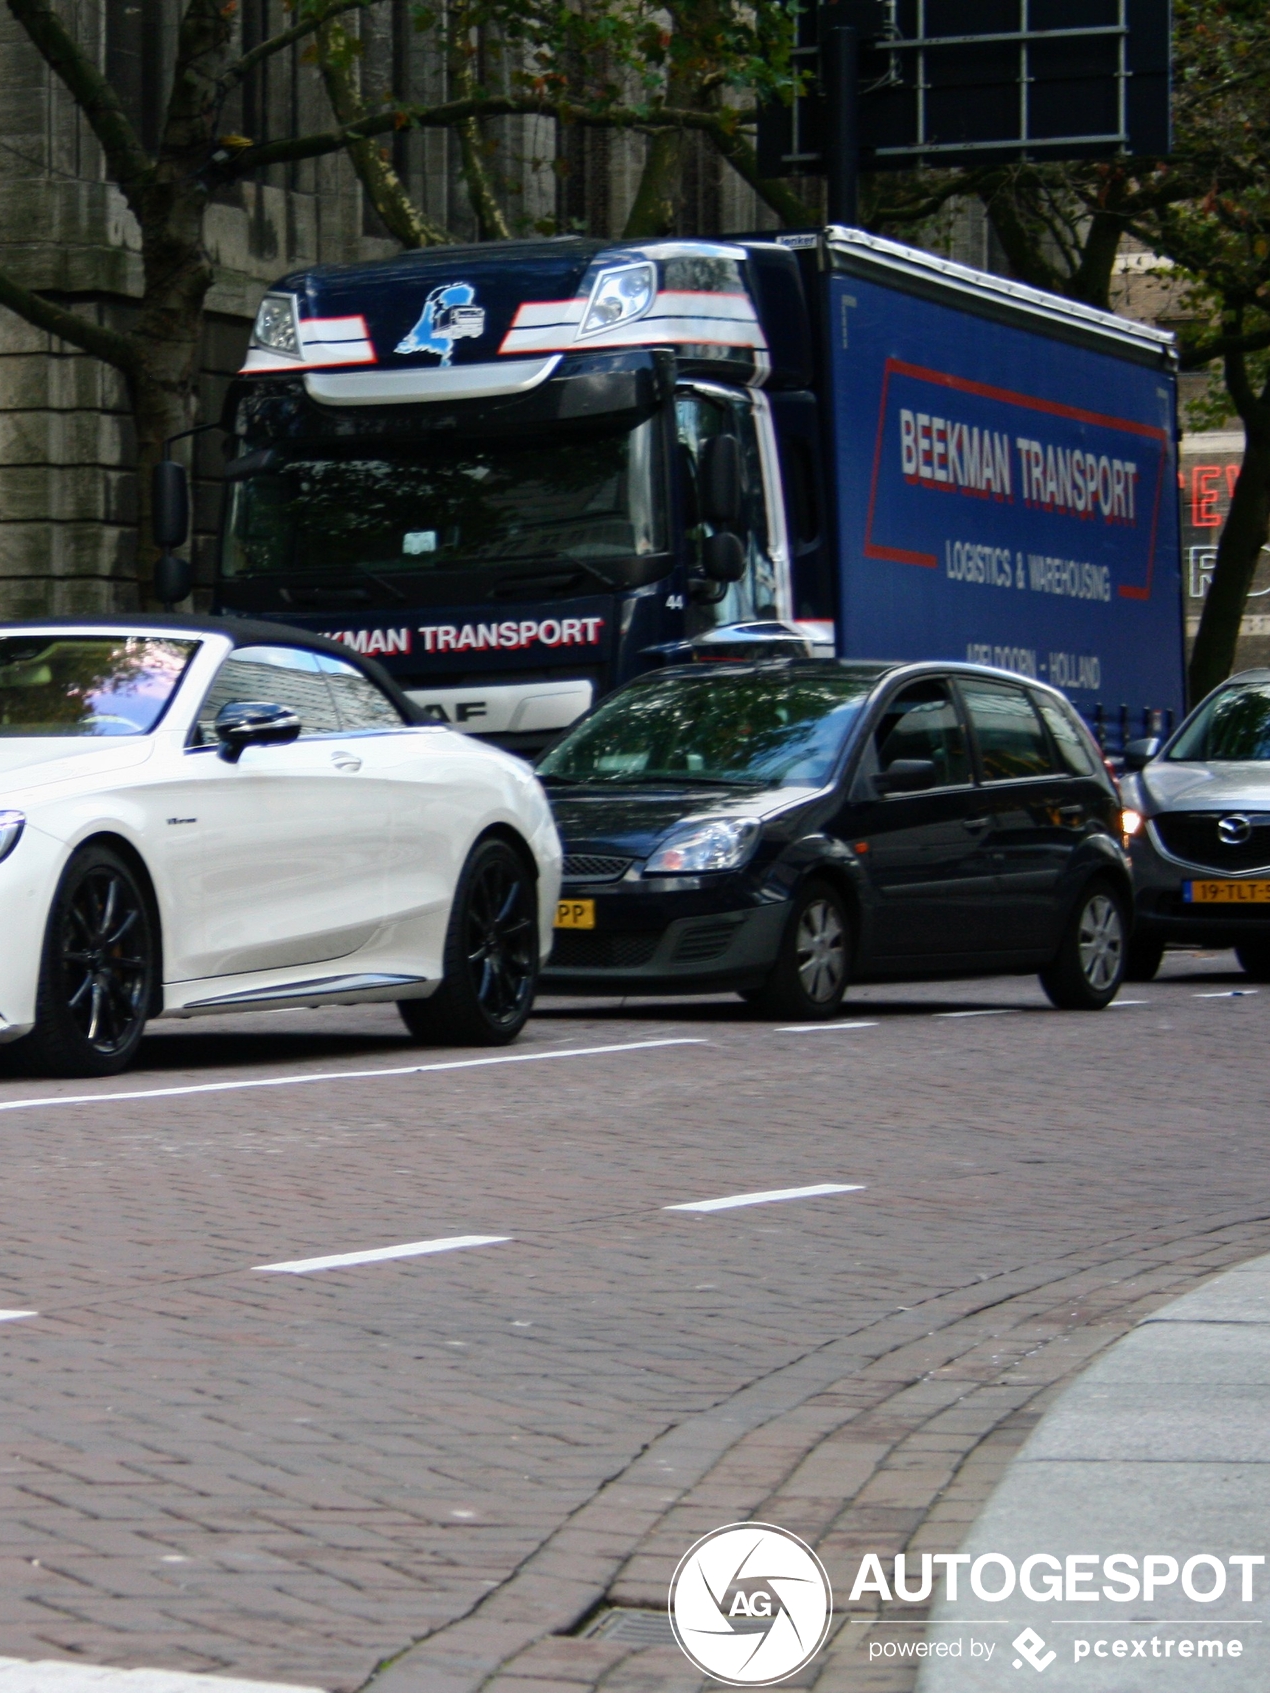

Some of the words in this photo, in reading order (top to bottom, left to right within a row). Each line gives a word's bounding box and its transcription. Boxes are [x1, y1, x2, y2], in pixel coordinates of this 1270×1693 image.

[899, 408, 1012, 497] BEEKMAN
[1016, 437, 1137, 520] TRANSPORT
[945, 540, 1012, 588] LOGISTICS
[1016, 550, 1026, 590] &
[1028, 554, 1111, 602] WAREHOUSING
[418, 616, 602, 652] TRANSPORT
[1050, 652, 1100, 691] HOLLAND
[424, 702, 488, 724] AF
